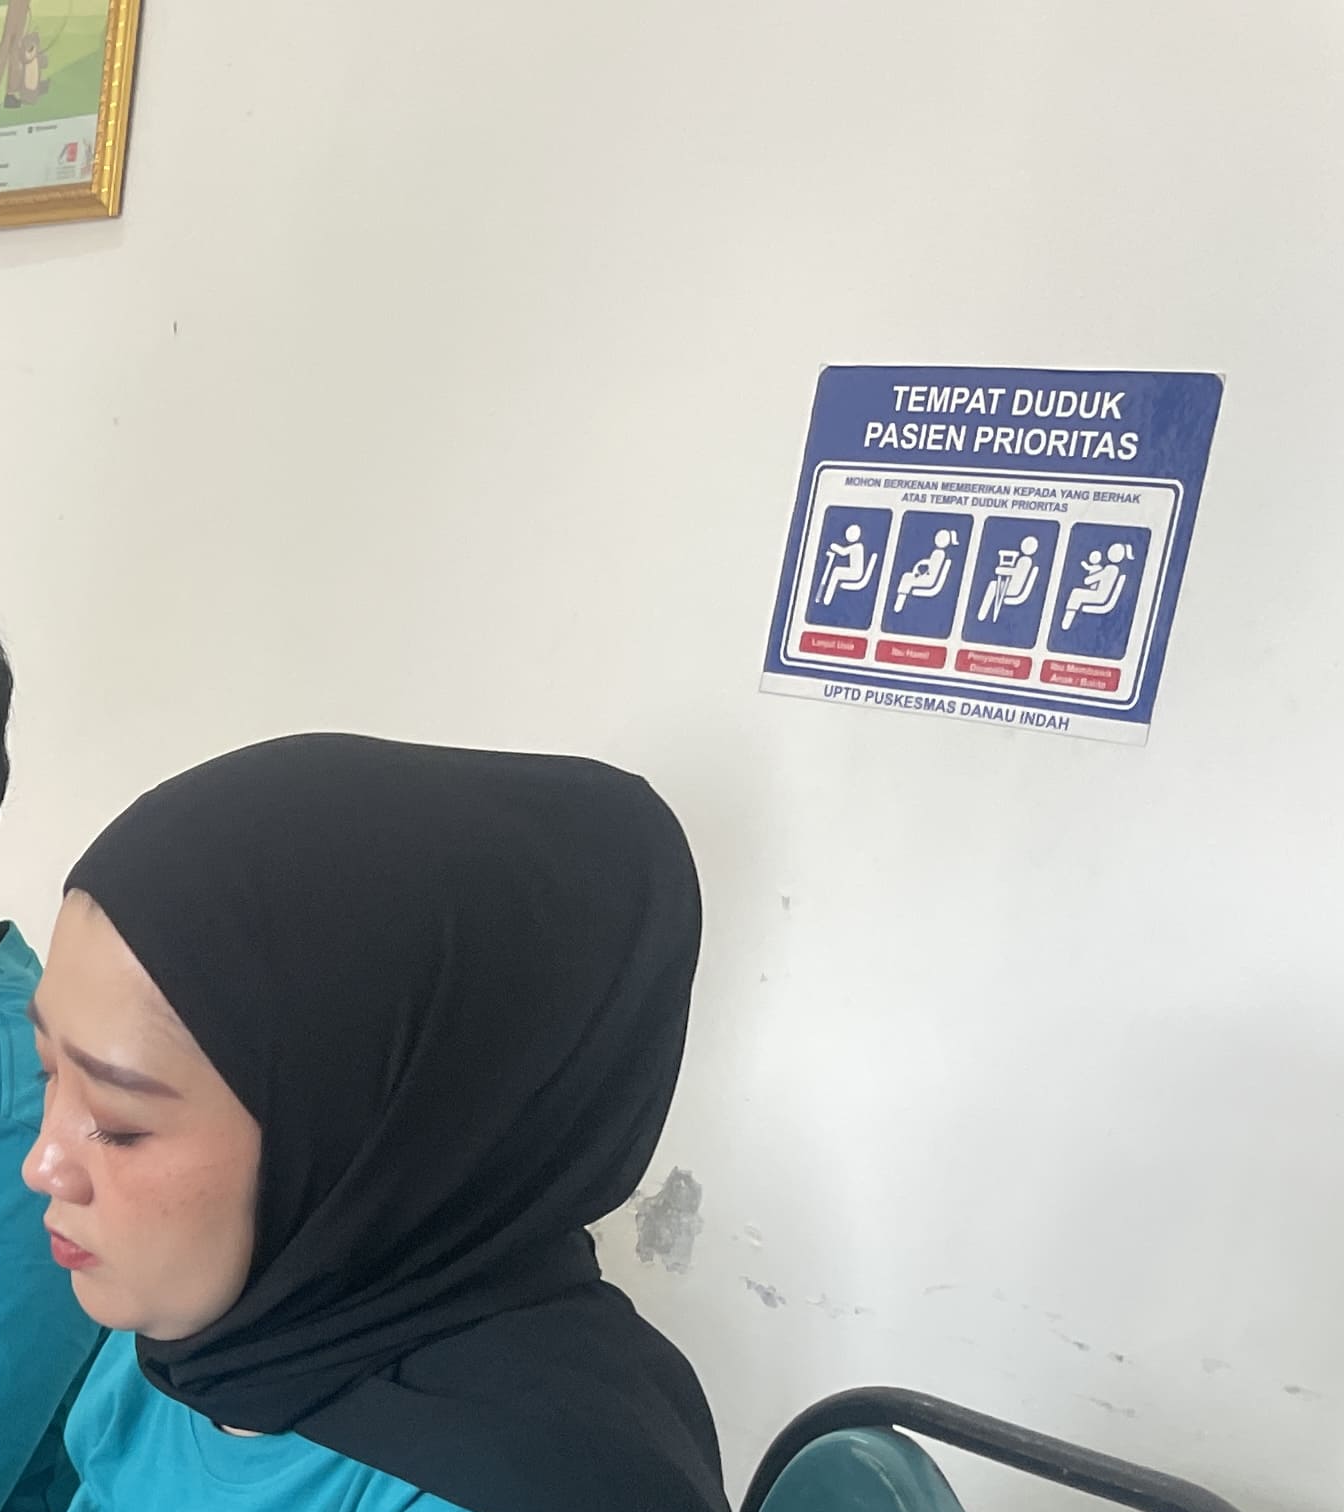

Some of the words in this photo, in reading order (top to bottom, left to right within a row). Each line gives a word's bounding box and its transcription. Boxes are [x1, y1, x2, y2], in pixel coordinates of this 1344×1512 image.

[892, 385, 1006, 417] TEMPAT
[1011, 387, 1125, 420] DUDUK
[864, 422, 969, 452] PASIEN
[973, 425, 1141, 460] PRIORITAS
[845, 477, 881, 488] MOHON
[883, 478, 939, 491] BERKENAN
[940, 481, 1011, 496] MEMBERIKAN
[1013, 485, 1057, 499] KEPADA
[1060, 488, 1090, 501] YANG
[1092, 491, 1141, 504] BERHAK
[901, 493, 928, 503] ATAS
[930, 494, 969, 506] TEMPAT
[971, 496, 1008, 509] DUDUK
[1011, 499, 1068, 513] PRIORITAS
[823, 684, 861, 701] UPTD
[864, 690, 956, 714] PUSKESMAS
[959, 702, 1016, 722] DANAU
[1019, 712, 1070, 731] INDAH
